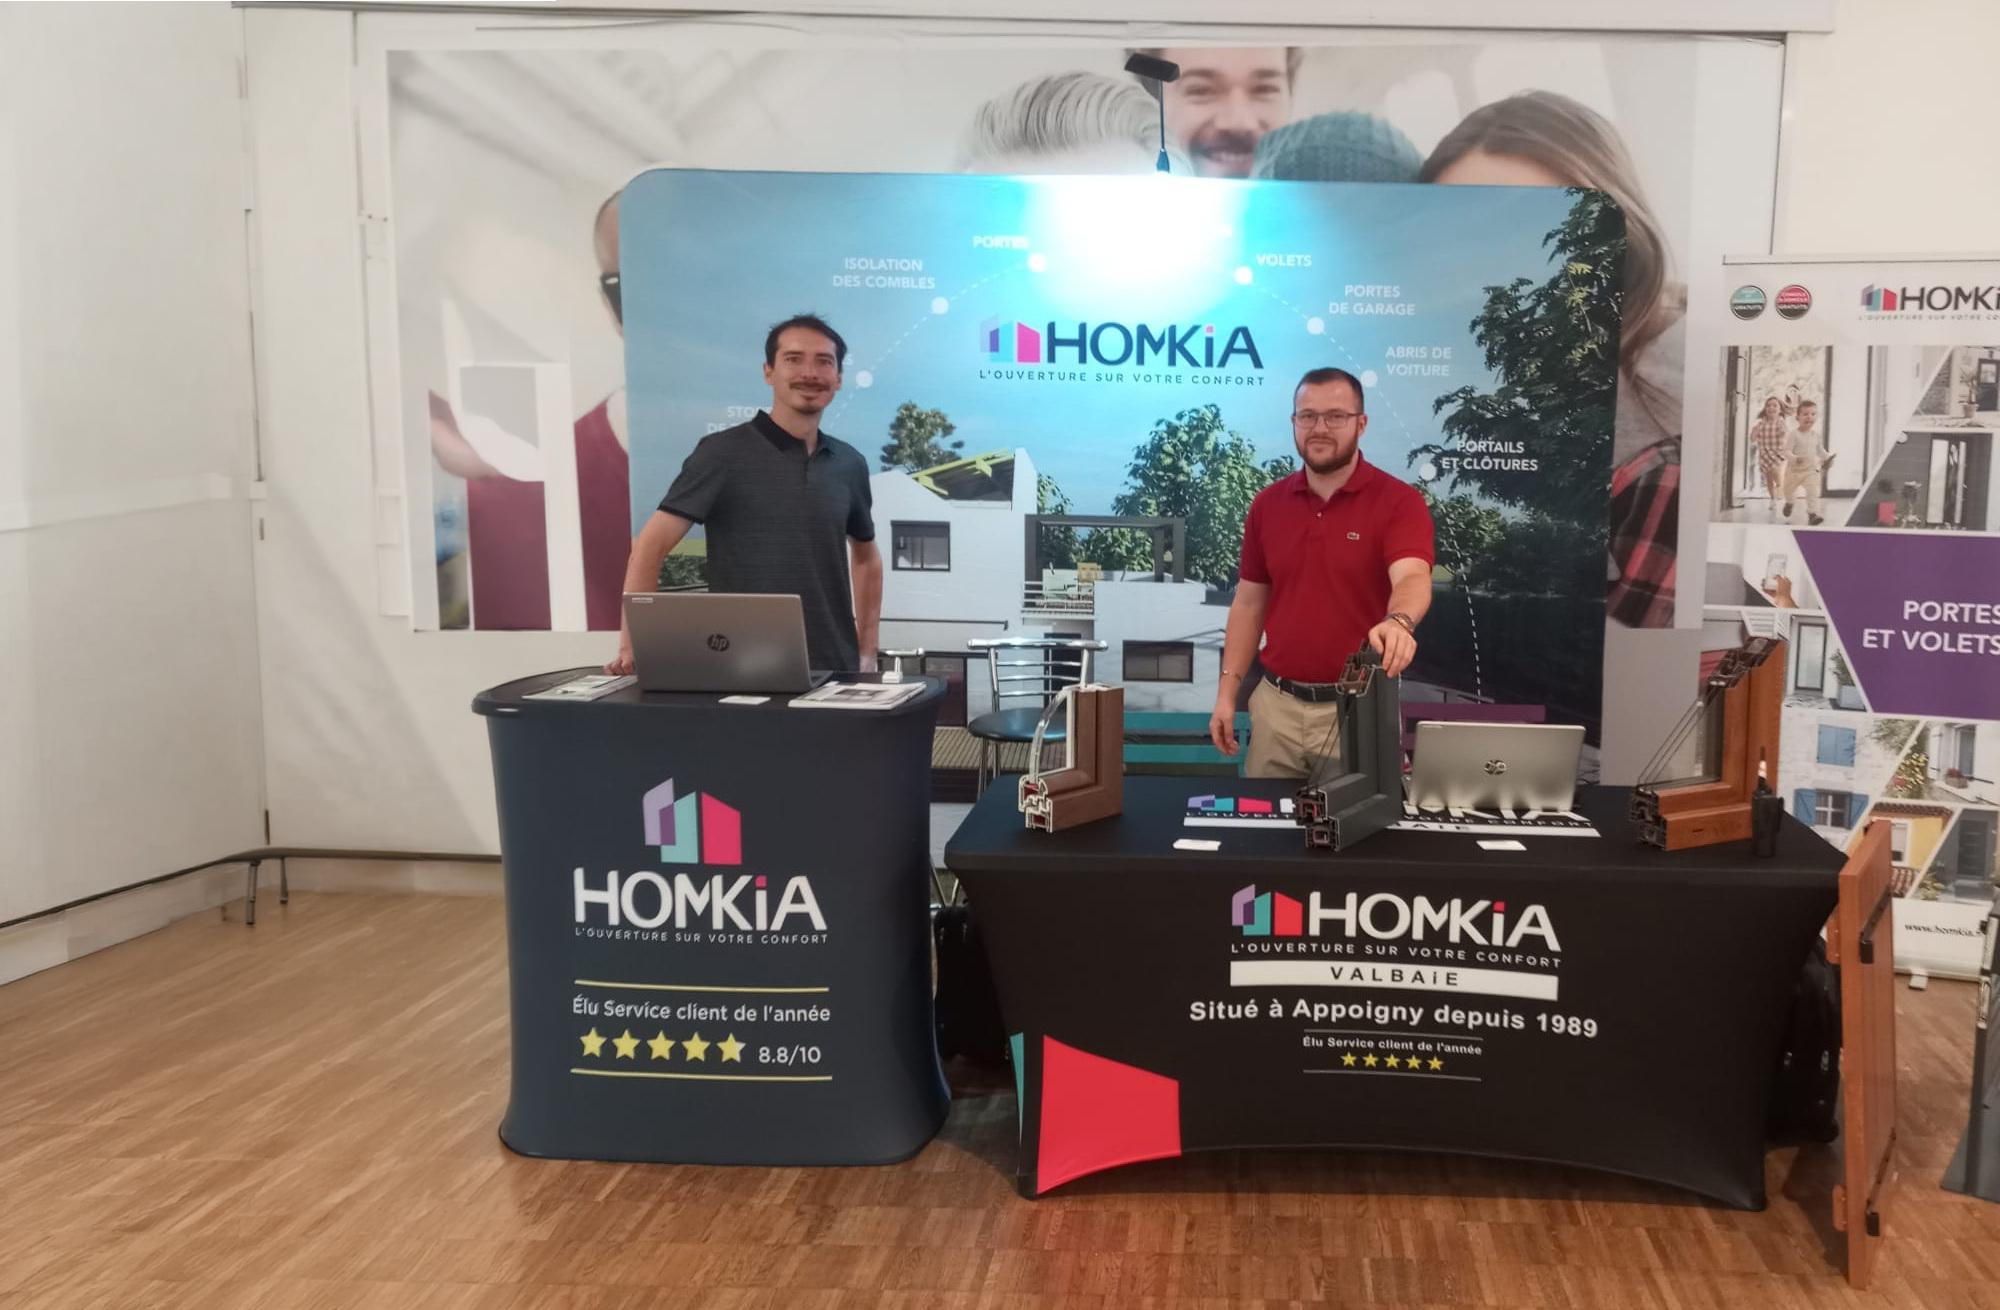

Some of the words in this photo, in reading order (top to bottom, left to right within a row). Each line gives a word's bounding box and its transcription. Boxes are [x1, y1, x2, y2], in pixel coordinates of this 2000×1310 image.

[845, 257, 923, 271] ISOLATION
[1255, 253, 1312, 267] VOLETS
[832, 275, 860, 287] DES
[865, 276, 935, 289] COMBLES
[1344, 284, 1400, 298] PORTES
[1900, 286, 2000, 311] HOMKi
[1329, 302, 1349, 314] DE
[1353, 302, 1416, 316] GARAGE
[1385, 346, 1427, 359] ABRIS
[1431, 346, 1452, 359] DE
[979, 370, 1087, 382] L'OUVERTURE
[1096, 373, 1124, 383] SUR
[1133, 373, 1183, 384] VOTRE
[1191, 375, 1265, 387] CONFORT
[1386, 364, 1450, 377] VOITURE
[1457, 440, 1525, 453] PORTAILS
[1441, 457, 1459, 469] ET
[1463, 455, 1539, 471] CLÔTURES
[1903, 600, 2000, 625] PORTES
[1862, 628, 1896, 649] ET
[1901, 629, 2000, 655] VOLETS
[575, 927, 668, 942] L'OUVERTURE
[675, 932, 701, 943] SUR
[708, 934, 753, 944] VOTRE
[761, 934, 828, 945] CONFORT
[1231, 943, 1354, 954] L'OUVERTURE
[1365, 944, 1398, 955] SUR
[1408, 947, 1466, 960] VOTRE
[1475, 951, 1561, 968] CONFORT
[573, 993, 599, 1015] Élu
[604, 1000, 671, 1019] Service
[676, 1003, 727, 1021] client
[734, 1004, 757, 1022] de
[763, 1005, 831, 1022] l'année
[1189, 998, 1259, 1021] Situé
[1269, 998, 1283, 1018] à
[1292, 998, 1424, 1026] Appoigny
[1434, 1004, 1525, 1030] depuis
[1536, 1013, 1599, 1038] 1989
[1303, 1036, 1323, 1047] Élu
[1328, 1037, 1374, 1049] Service
[1378, 1038, 1414, 1050] client
[1417, 1041, 1433, 1052] de
[1437, 1042, 1482, 1056] l'année
[758, 1046, 822, 1066] 8.8/10
